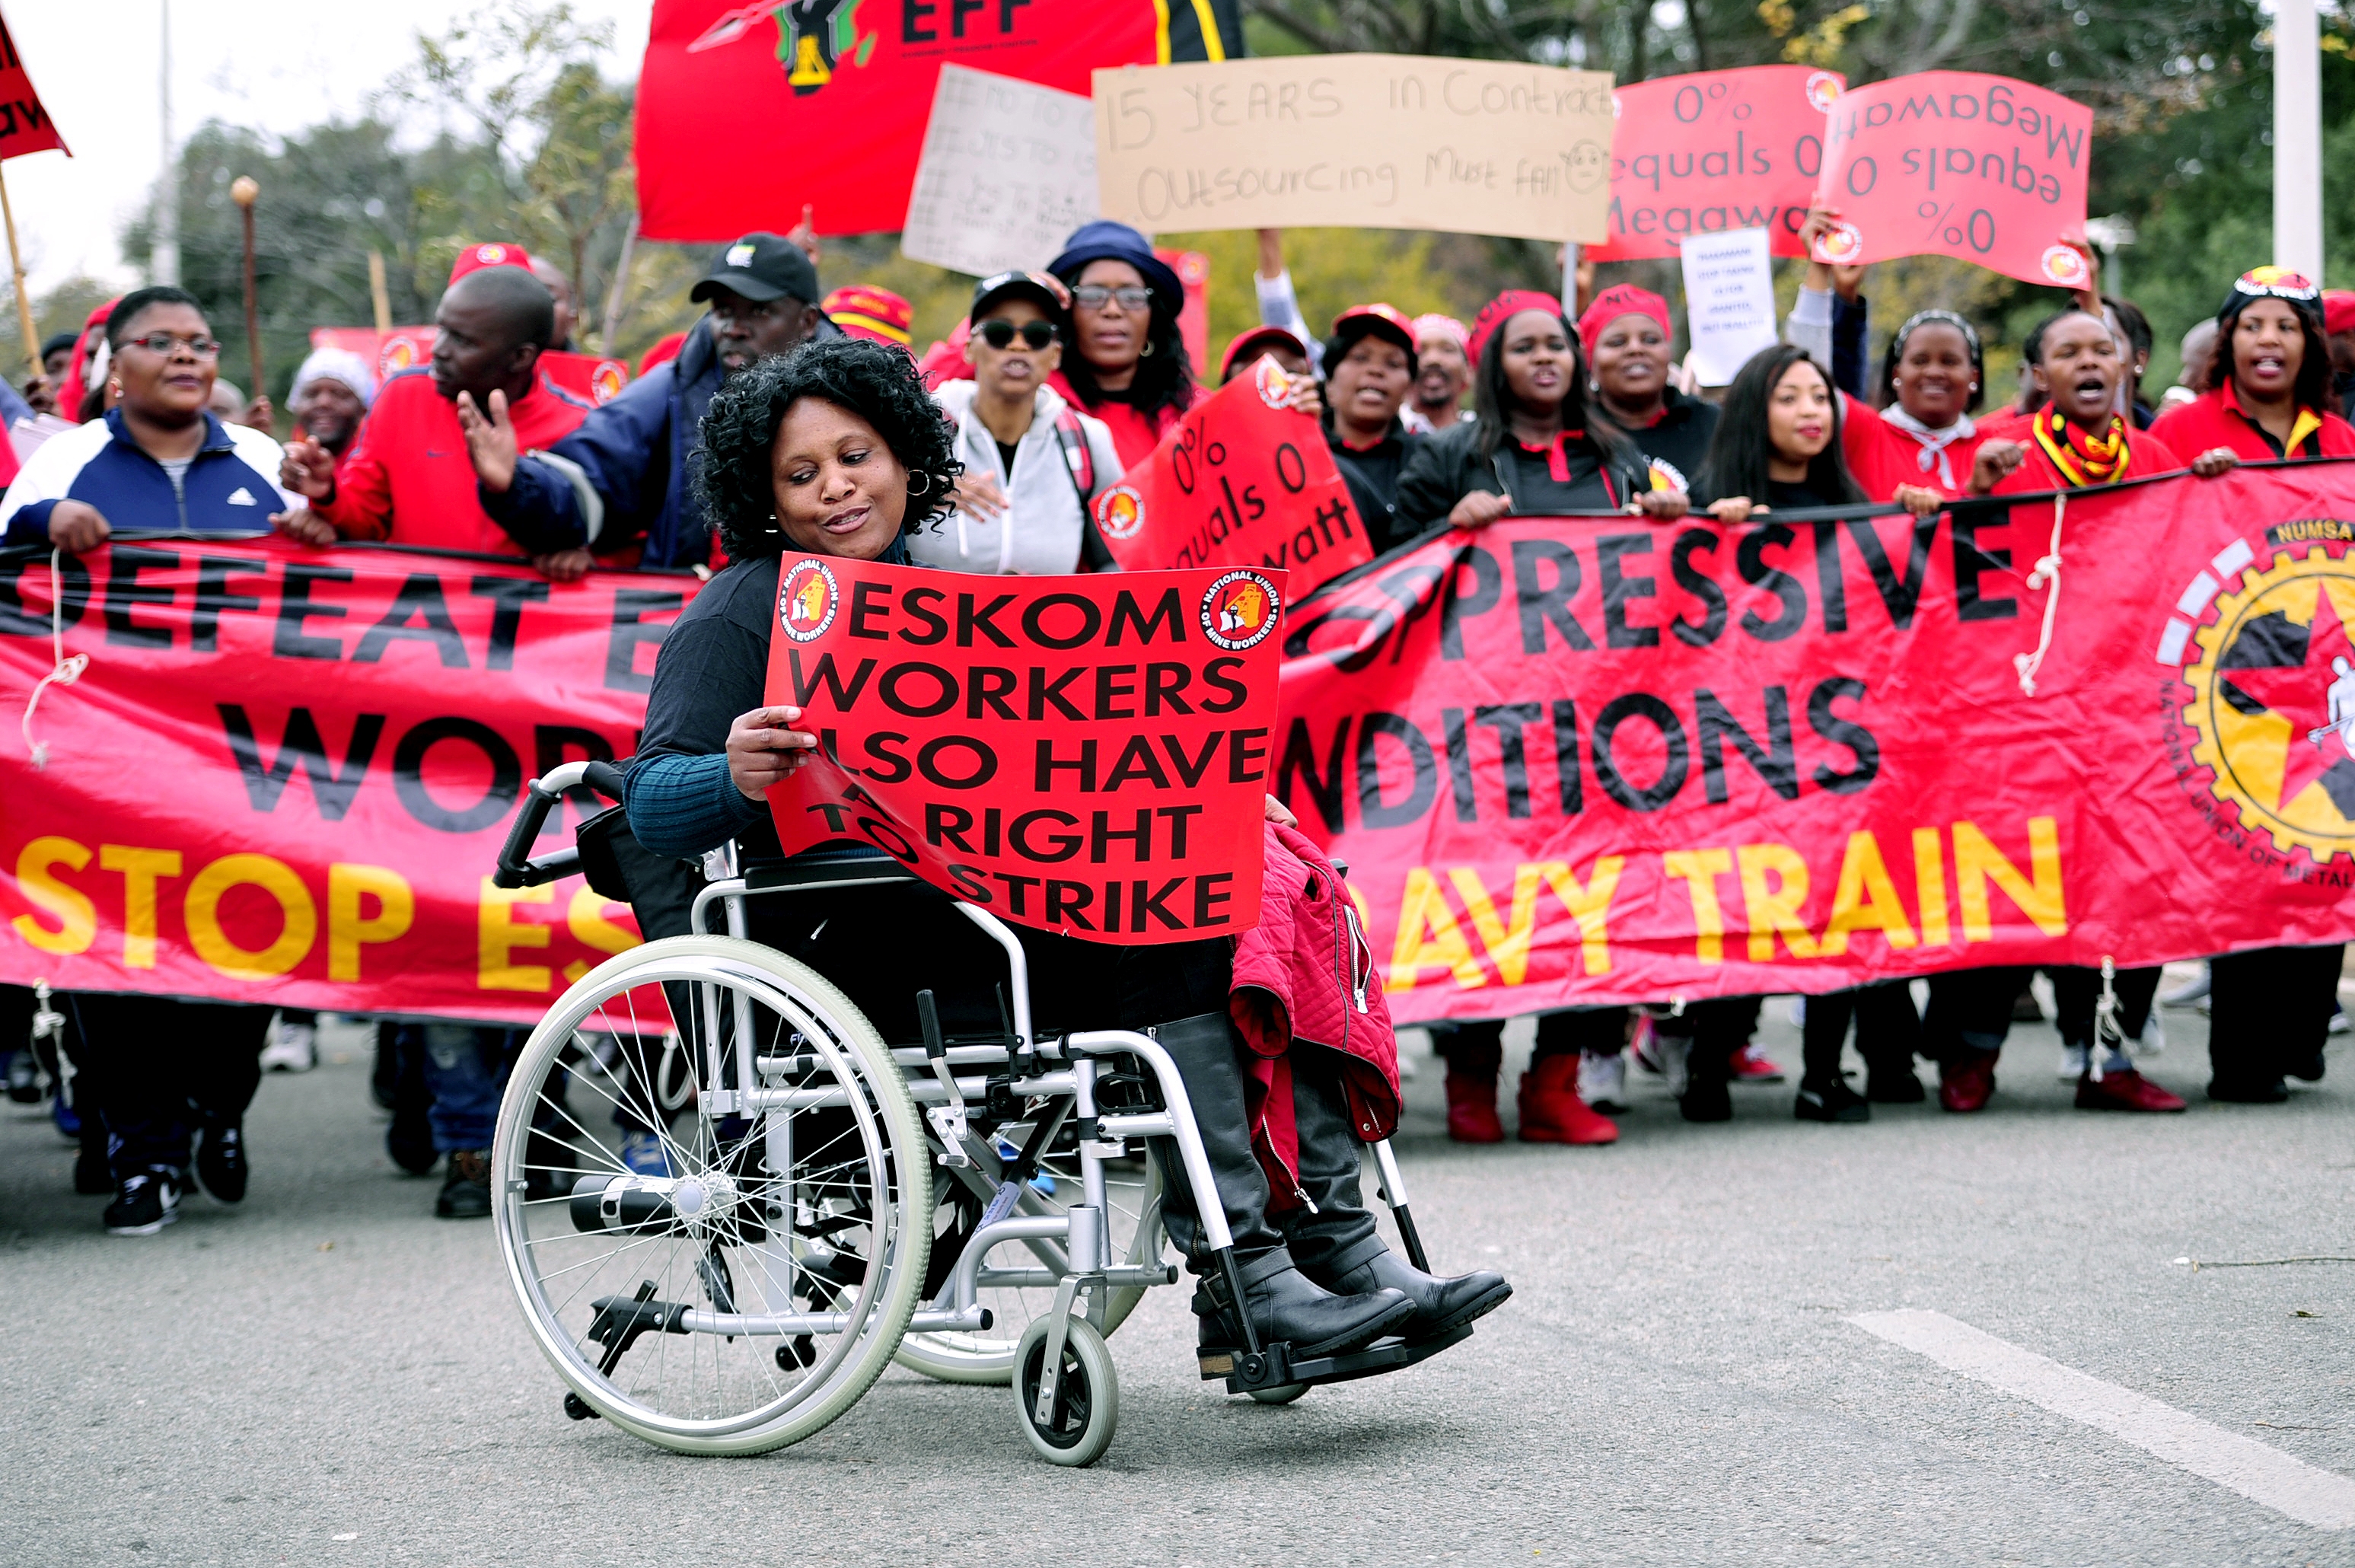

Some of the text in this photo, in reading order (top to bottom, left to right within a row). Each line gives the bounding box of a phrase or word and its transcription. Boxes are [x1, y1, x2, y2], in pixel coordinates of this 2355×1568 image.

[1107, 86, 1156, 153] 15
[1181, 77, 1342, 134] YEARS
[1675, 81, 1752, 123] 0%
[1833, 84, 2083, 168] Megawatt
[1610, 131, 1822, 192] equals 0
[1847, 146, 2061, 203] equals 0
[1172, 416, 1226, 495] 0%
[1276, 443, 1305, 494] 0
[1248, 497, 1353, 569] watt
[2277, 519, 2353, 543] NUMSA
[0, 543, 550, 671] DEFEAT
[783, 559, 838, 601] NATIONAL UNION
[848, 581, 1186, 650] ESKOM
[1203, 571, 1279, 606] NATIONAL UNION
[1285, 508, 2019, 674] OPPRESSIVE
[779, 598, 835, 641] OF MINE WORKERS
[1201, 612, 1276, 649] OF MINE WORKERS
[788, 649, 1248, 721] WORKERS
[215, 703, 642, 834] WOR
[807, 727, 1268, 792] LSO HAVE
[1278, 676, 1878, 835] NDITIONS
[2160, 680, 2192, 792] NATIONAL
[2190, 791, 2246, 849] UNION
[2250, 846, 2279, 868] OF
[806, 803, 1233, 934] TO STRIKE
[925, 803, 1202, 864] RIGHT
[11, 836, 415, 983] STOP
[1347, 816, 2067, 993] AVY TRAIN
